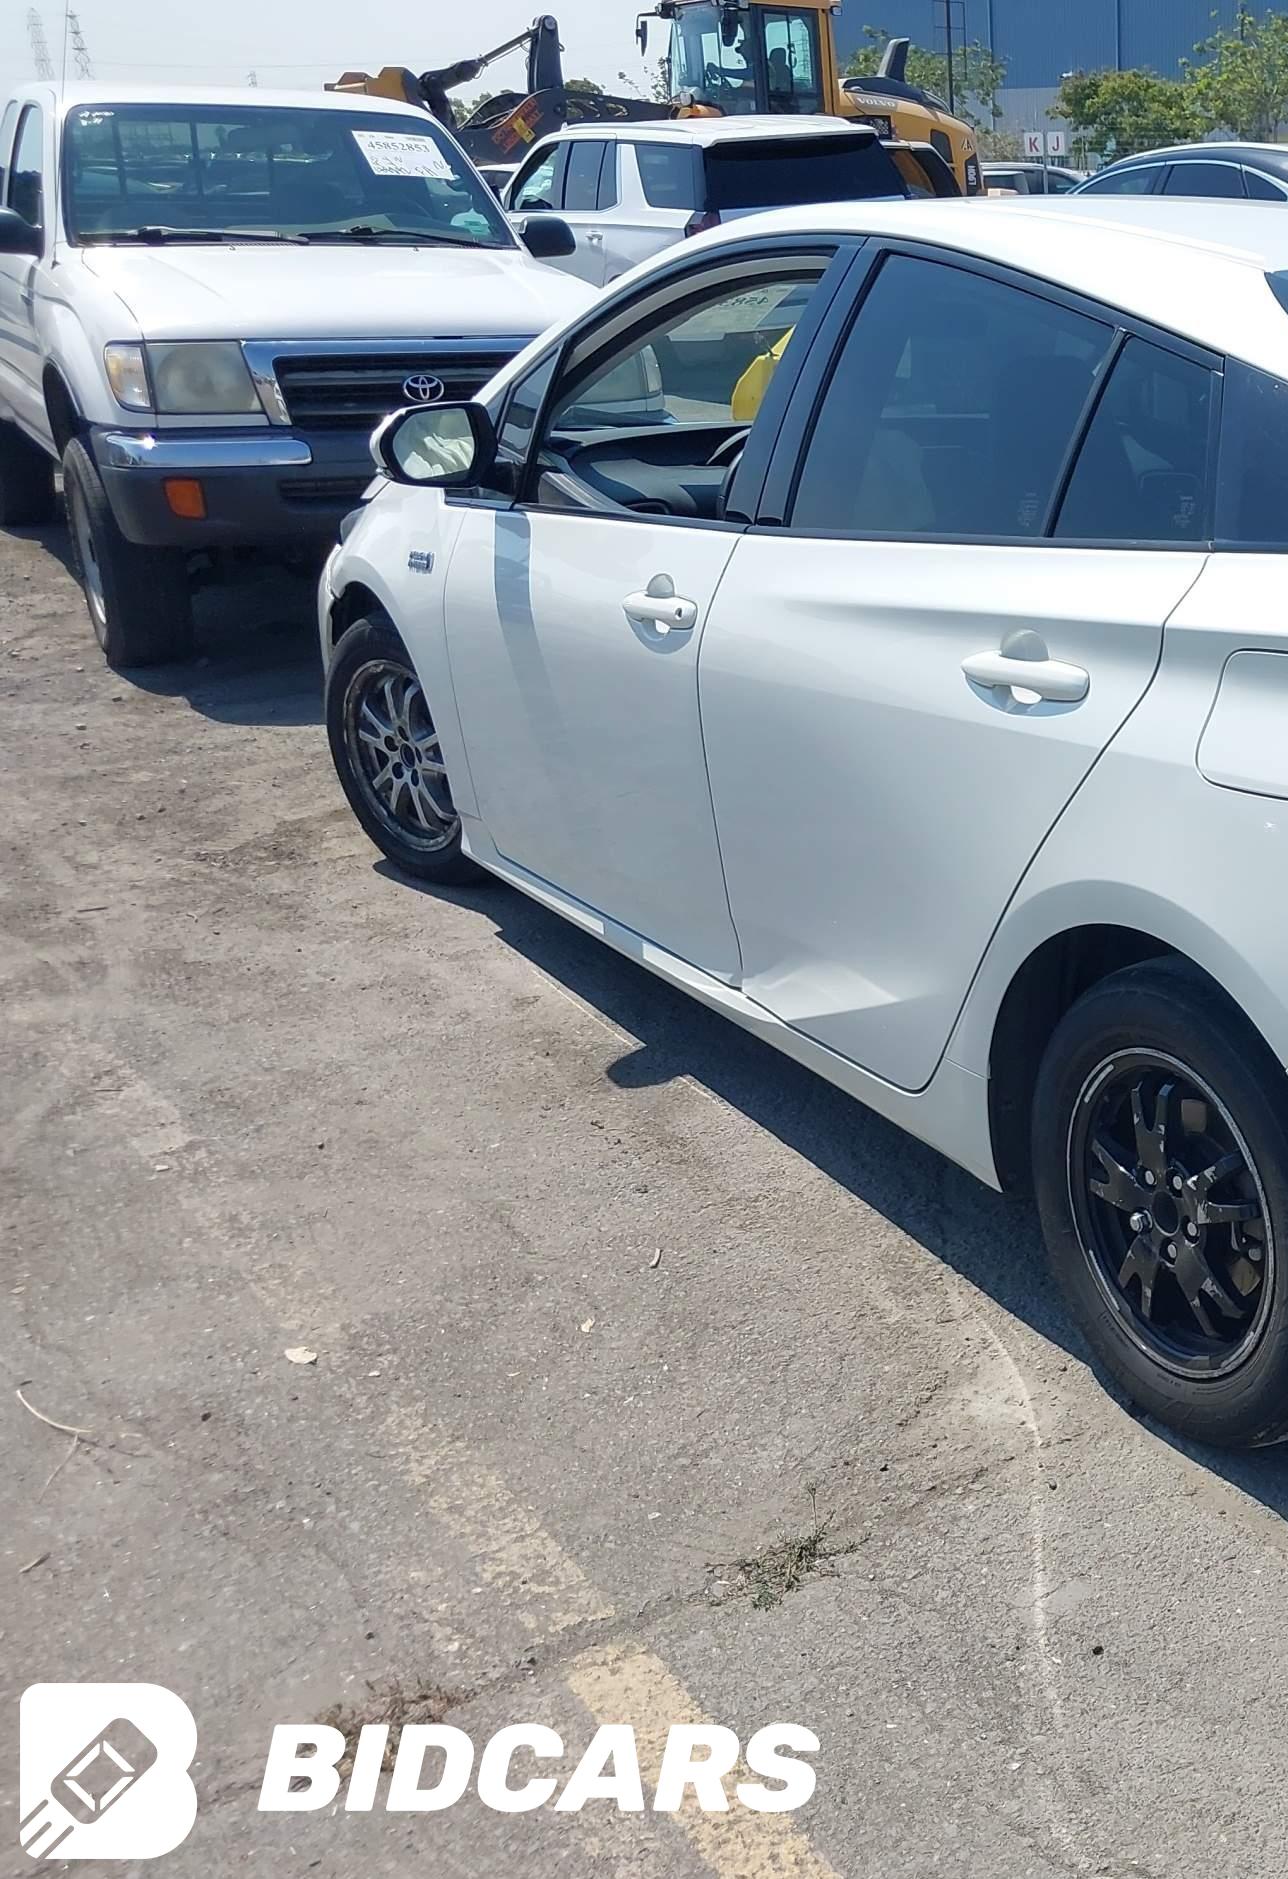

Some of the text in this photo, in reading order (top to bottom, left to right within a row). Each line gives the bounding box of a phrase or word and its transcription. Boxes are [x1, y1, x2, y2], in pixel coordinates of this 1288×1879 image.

[856, 97, 896, 108] VOLVO
[1028, 136, 1040, 153] K
[1051, 135, 1060, 152] J
